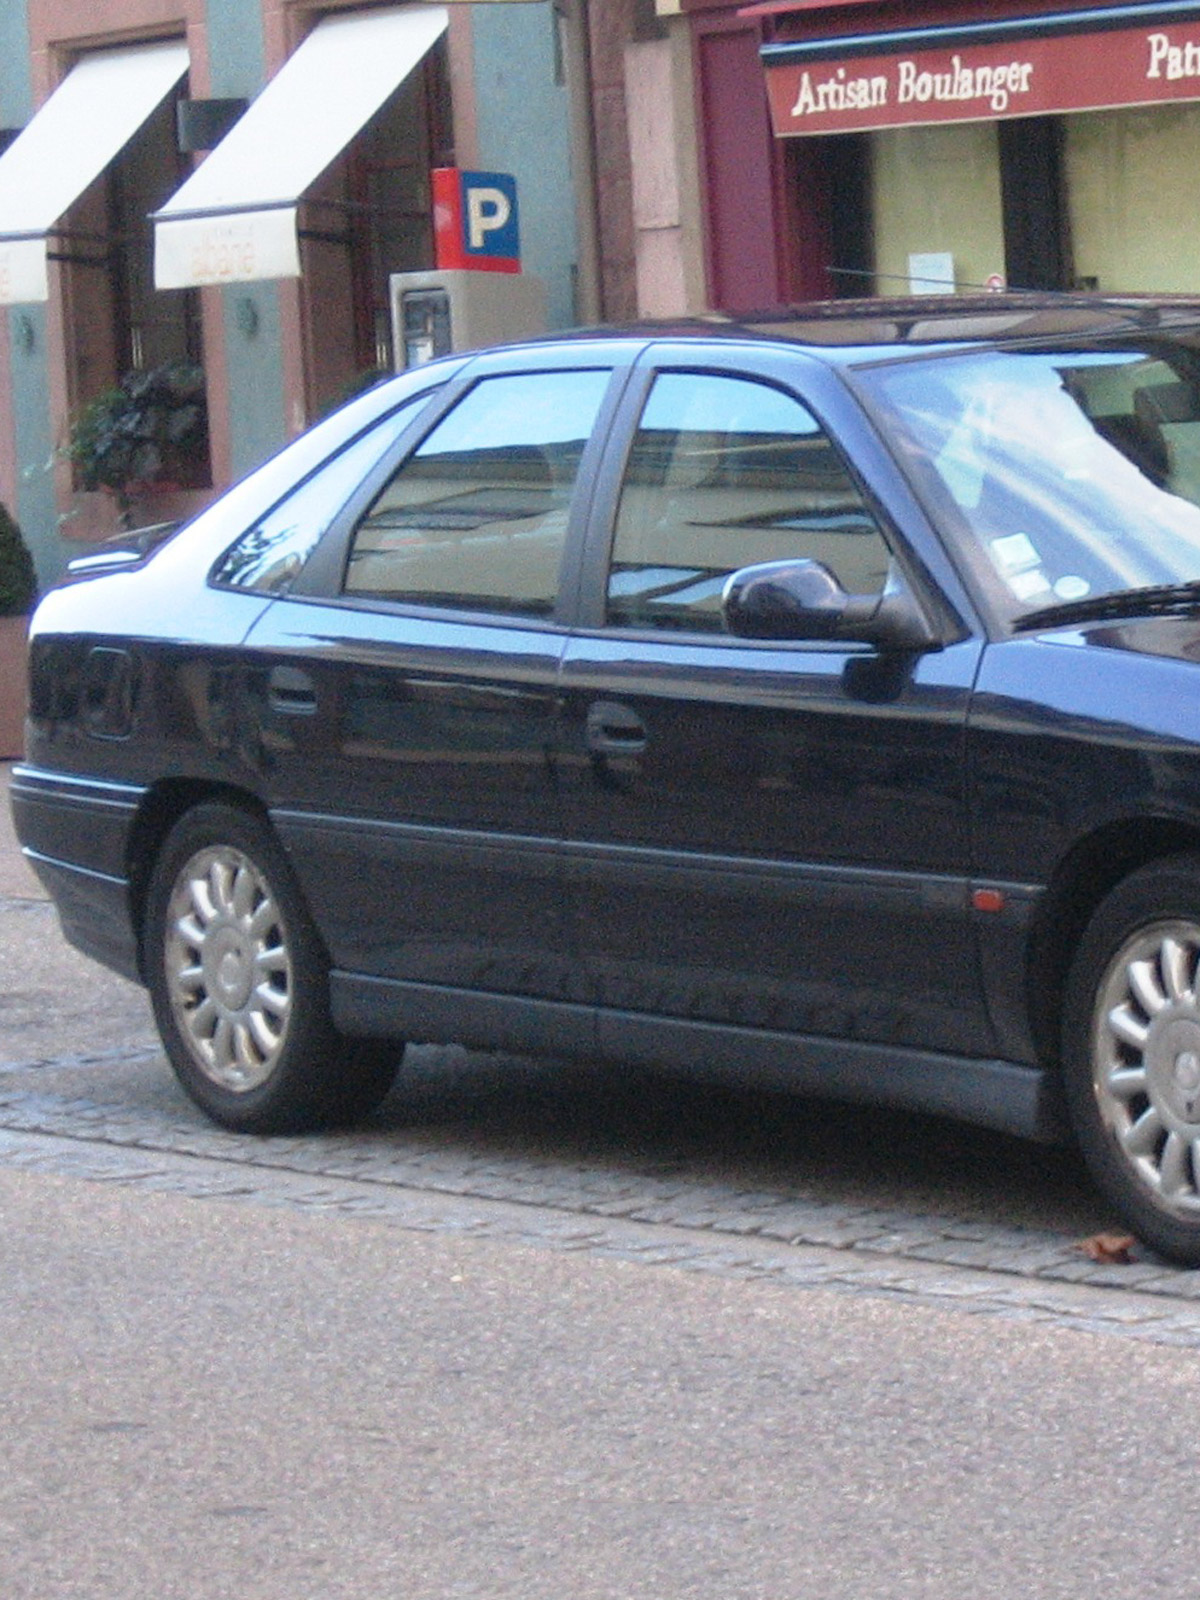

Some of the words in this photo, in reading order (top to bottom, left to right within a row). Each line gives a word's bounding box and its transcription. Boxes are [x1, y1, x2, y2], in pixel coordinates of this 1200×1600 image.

[791, 68, 887, 116] Artisan
[898, 55, 1033, 111] Boulanger
[467, 187, 511, 248] P
